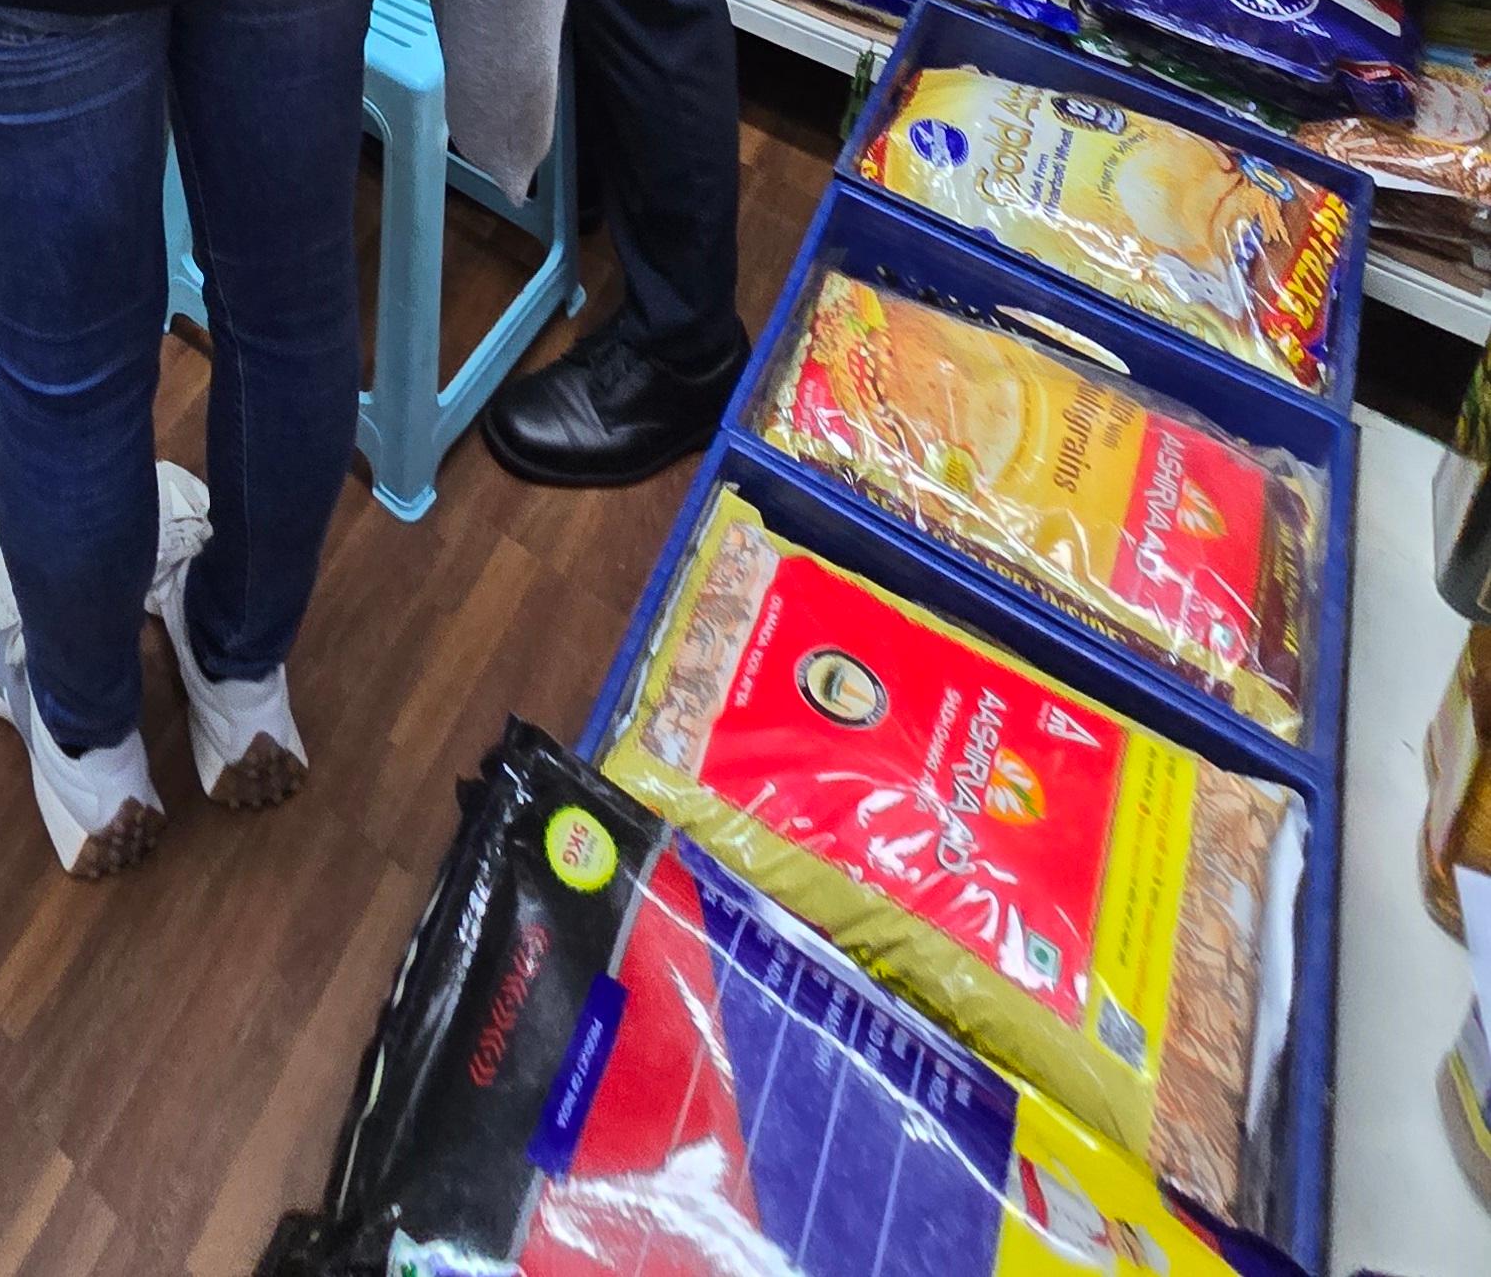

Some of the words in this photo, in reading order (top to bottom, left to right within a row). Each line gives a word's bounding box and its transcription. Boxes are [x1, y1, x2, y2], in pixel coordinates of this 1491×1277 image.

[974, 114, 1024, 206] Gold
[1043, 168, 1066, 224] harbati
[1056, 128, 1076, 175] Wheat
[1050, 376, 1106, 496] ultigrains
[1134, 430, 1190, 586] AASHIRVAAD
[936, 683, 1010, 876] AASHIRVAAD
[560, 820, 590, 870] 5KG
